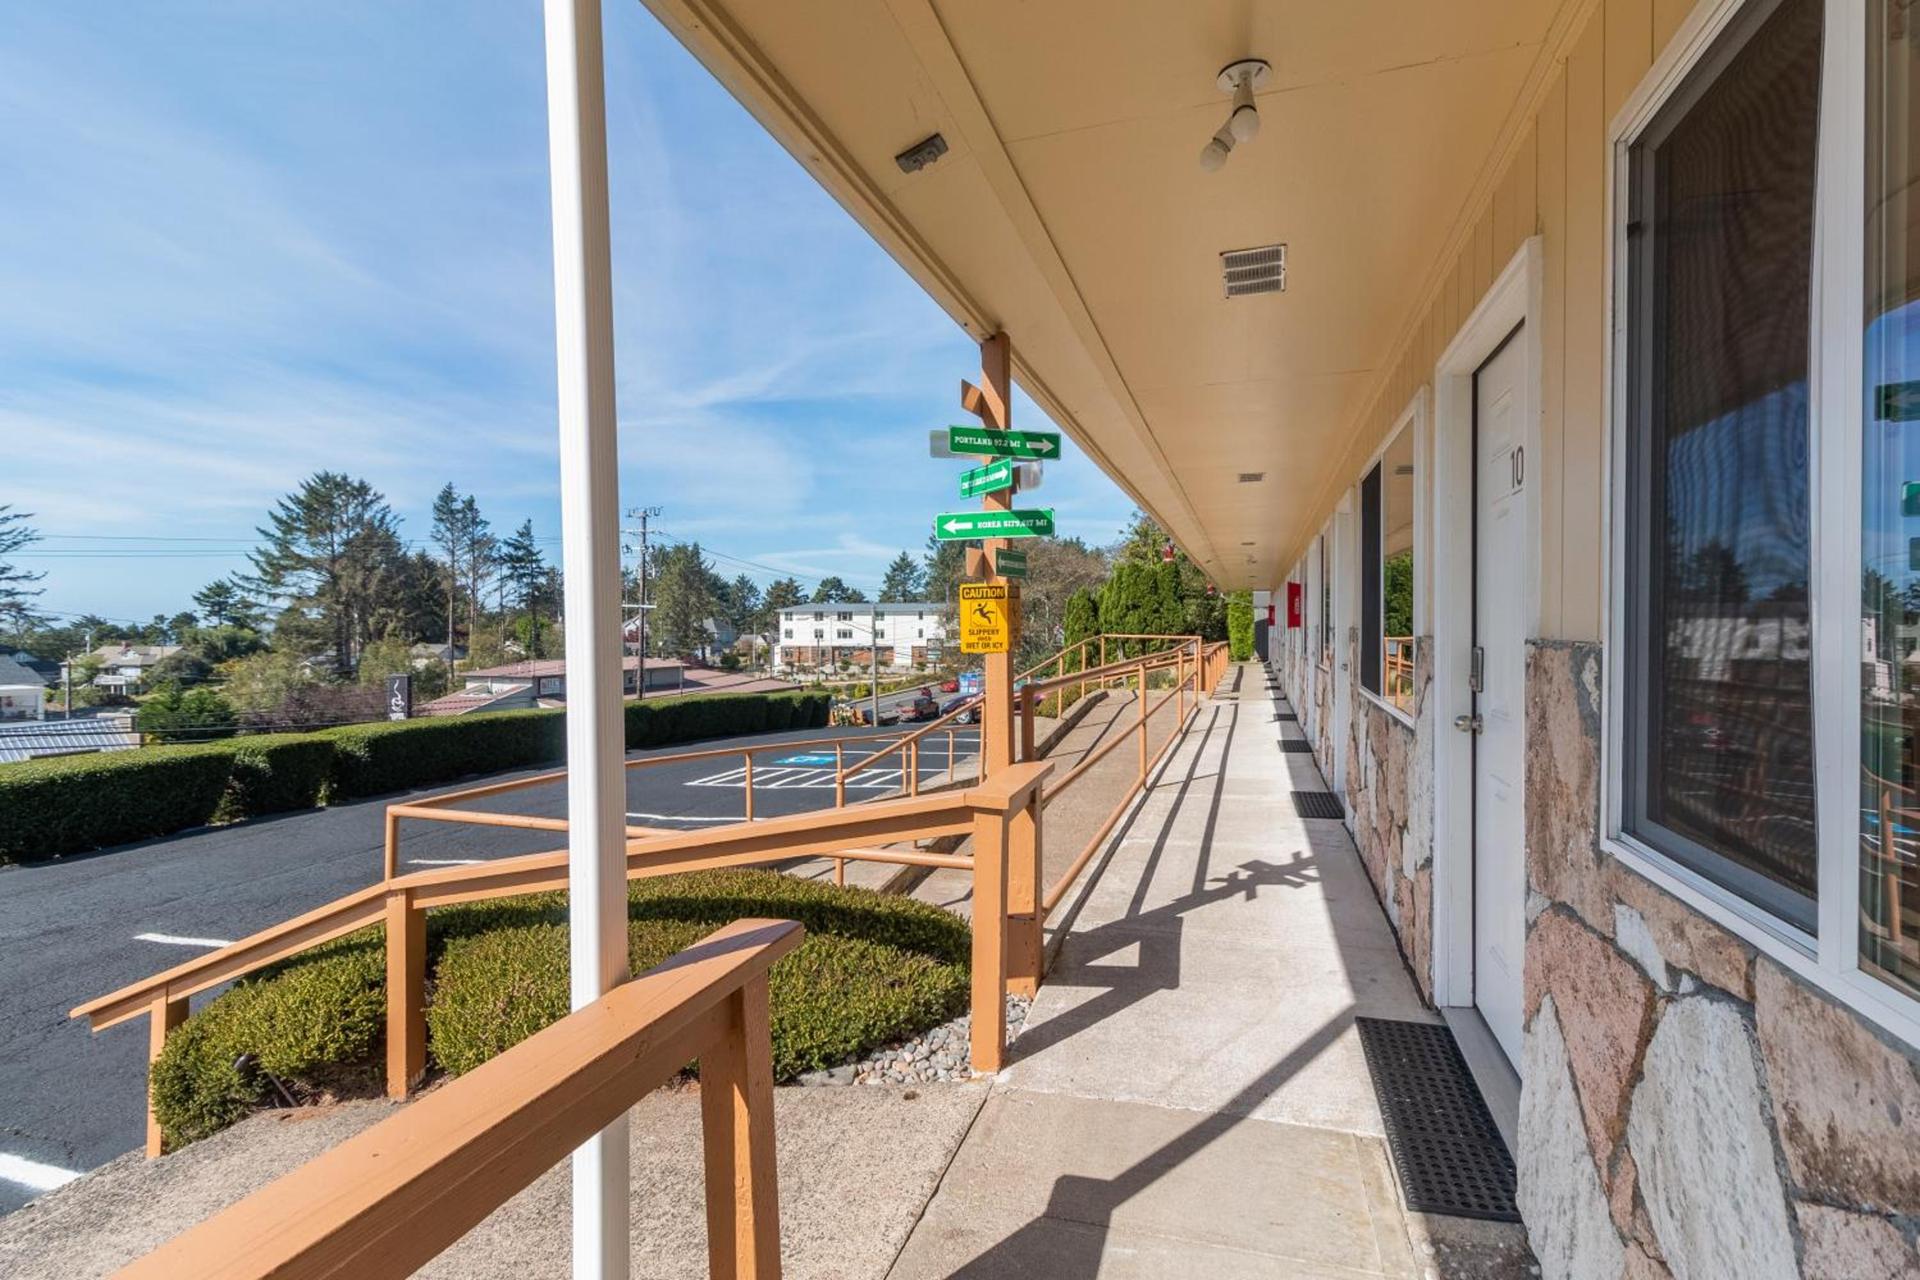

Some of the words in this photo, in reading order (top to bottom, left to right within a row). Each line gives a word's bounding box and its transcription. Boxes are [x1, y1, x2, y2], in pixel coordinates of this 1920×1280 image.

[954, 436, 993, 446] PORTLAND
[1511, 446, 1524, 489] 10
[963, 587, 1005, 599] CAUTION
[968, 628, 1000, 636] SLIPPERY
